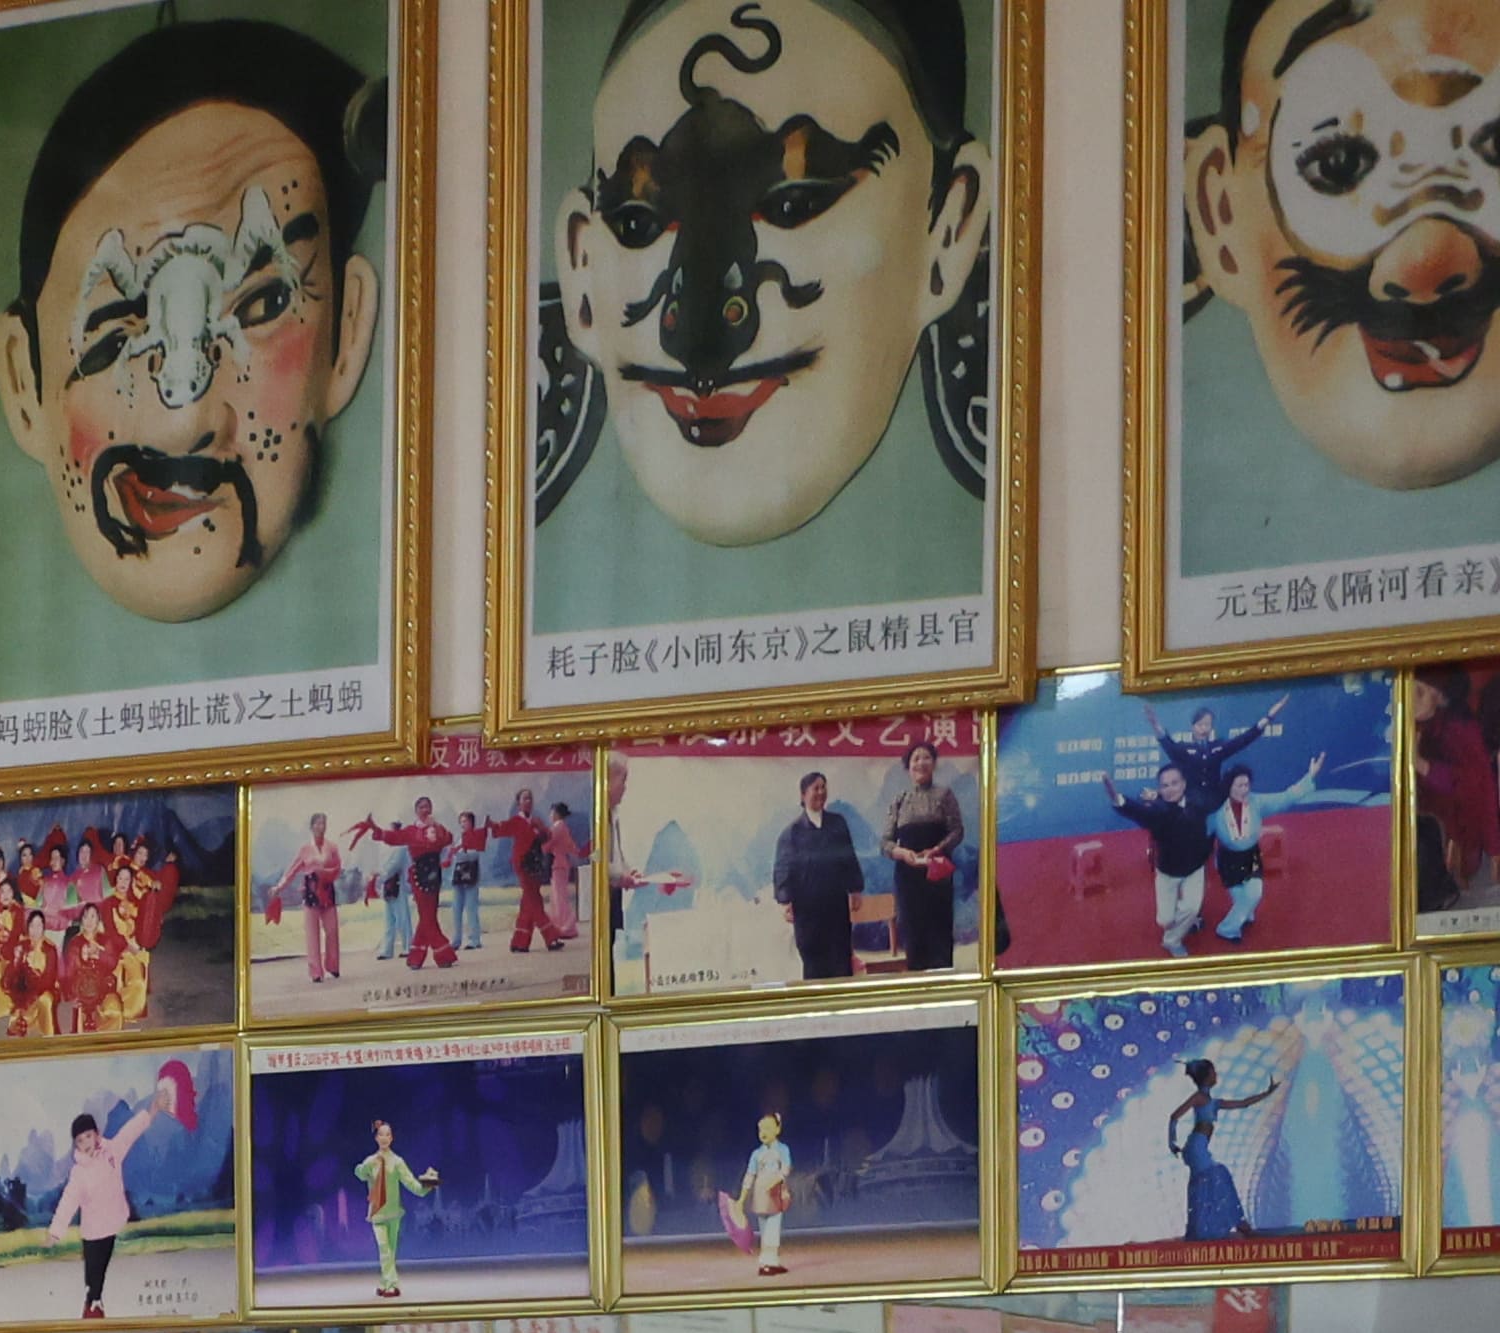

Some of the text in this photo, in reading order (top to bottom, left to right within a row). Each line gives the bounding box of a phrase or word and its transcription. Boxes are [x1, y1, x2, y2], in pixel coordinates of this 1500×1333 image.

[546, 609, 981, 681] 耗子脸《小闹东京》之鼠精县官
